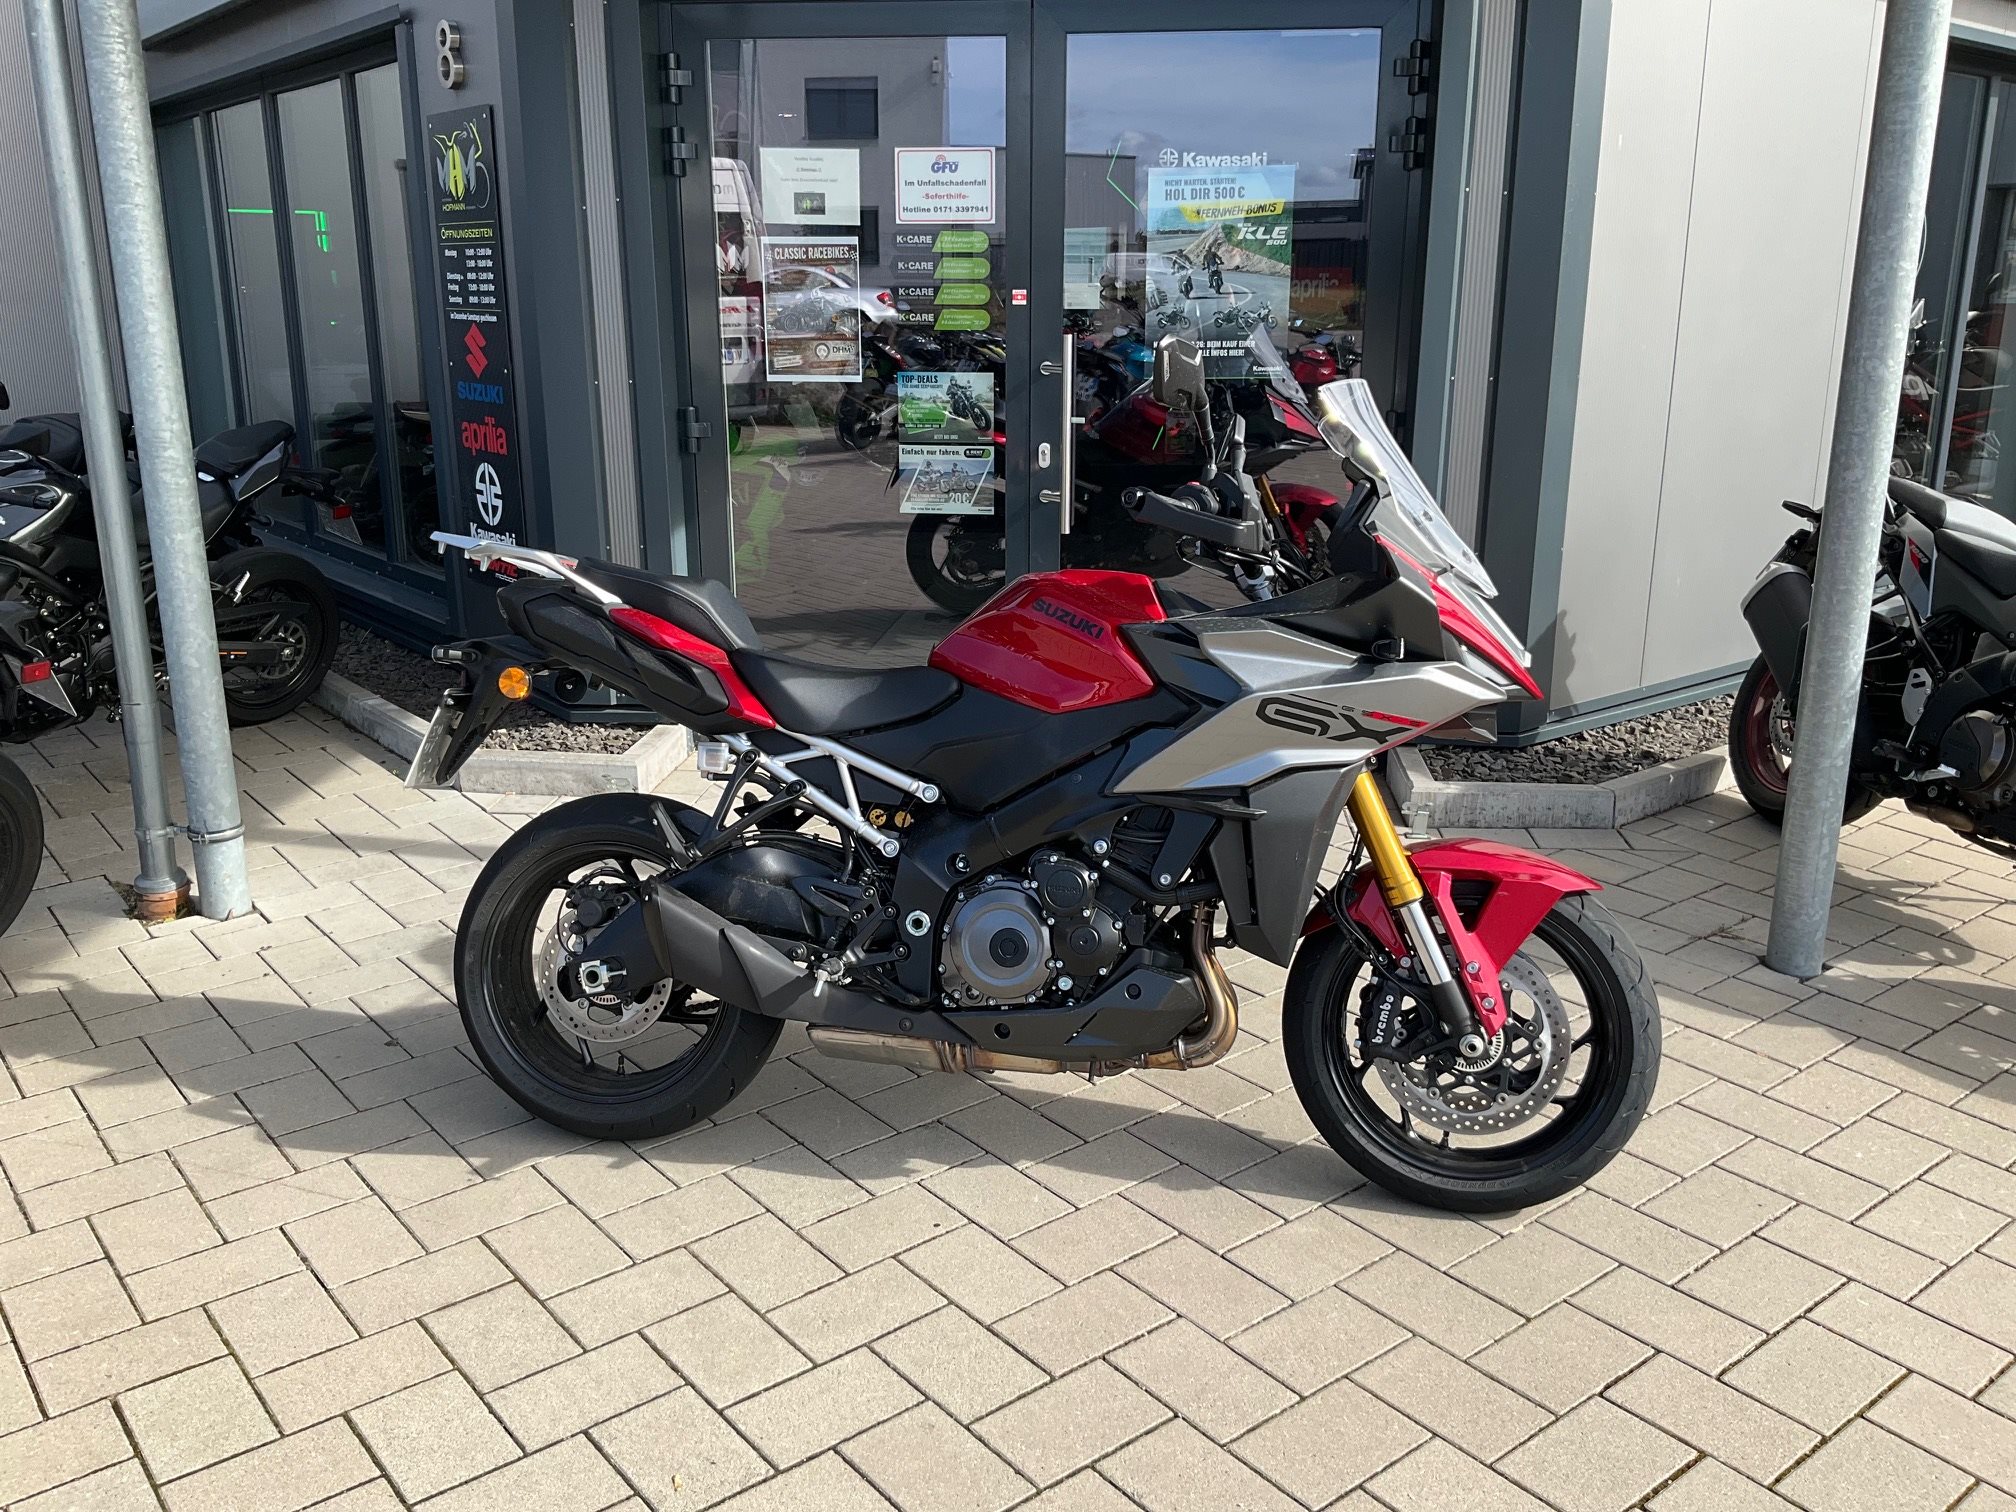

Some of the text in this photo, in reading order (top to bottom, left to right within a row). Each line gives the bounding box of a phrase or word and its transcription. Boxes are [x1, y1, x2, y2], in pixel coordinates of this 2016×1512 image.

[436, 19, 463, 88] 8
[1183, 151, 1268, 167] Kawasaki
[931, 161, 959, 174] GFÜ
[917, 179, 987, 187] Unfallschadenfall
[1164, 179, 1182, 187] NICHT
[1165, 186, 1246, 201] HOL DIR 500 €
[442, 202, 466, 211] HOFMANN
[440, 226, 493, 239] ÖFFNUNGSZEITEN
[1237, 226, 1288, 240] KLE
[774, 246, 849, 260] CLASSIC RACEBIKES
[1206, 340, 1222, 348] BEIM
[1222, 340, 1238, 348] KAUF
[1211, 349, 1228, 357] INFOS
[1228, 349, 1245, 357] HIER!
[901, 374, 939, 384] TOP-DEALS
[457, 381, 504, 405] SUZUKI
[461, 415, 508, 456] aprilia
[901, 447, 925, 456] Einfach
[939, 448, 961, 456] fahren.
[469, 521, 516, 547] Kawasaki
[1032, 598, 1105, 640] SUZUKI
[1371, 994, 1395, 1044] brembo
